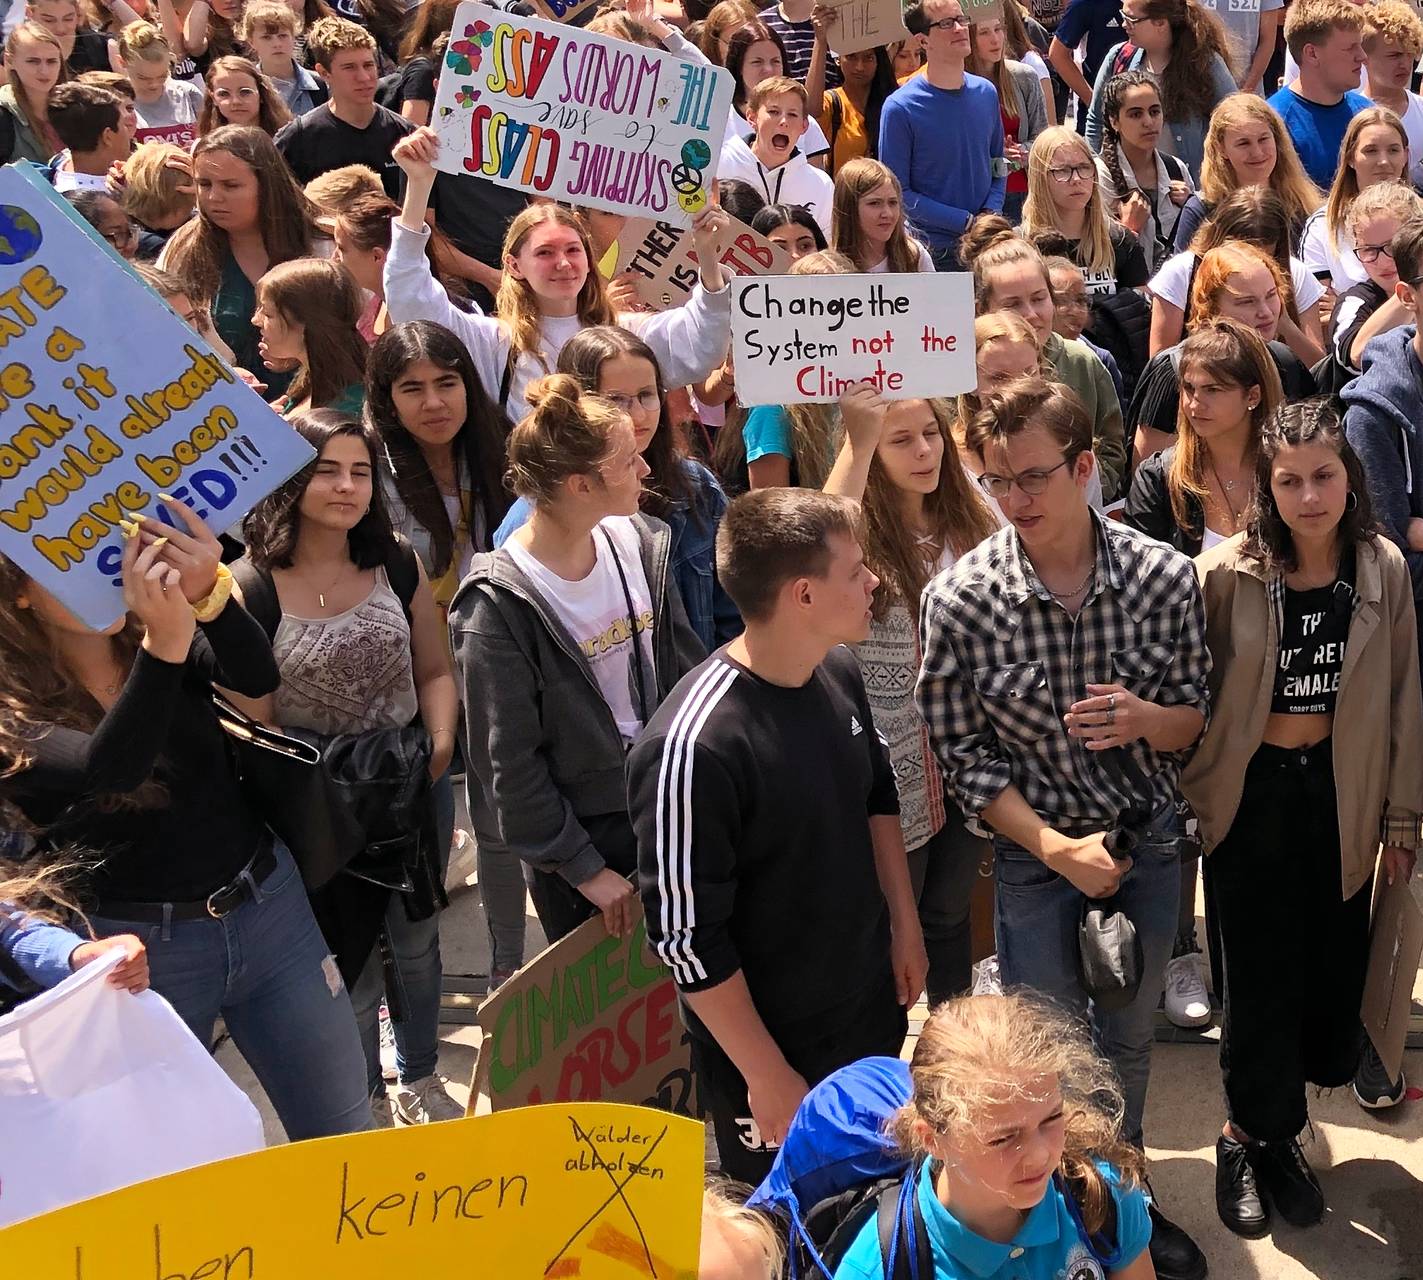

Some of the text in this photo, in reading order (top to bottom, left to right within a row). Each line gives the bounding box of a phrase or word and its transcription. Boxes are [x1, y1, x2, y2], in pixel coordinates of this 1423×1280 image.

[837, 5, 880, 41] THE
[486, 22, 560, 100] ASS
[670, 63, 718, 132] THE
[463, 105, 672, 213] SKIPPING CLASS
[518, 100, 675, 154] to save
[46, 326, 86, 362] a
[744, 325, 957, 366] System not the
[62, 362, 117, 411] it
[0, 344, 236, 533] would already
[32, 405, 239, 572] have been
[528, 978, 680, 1105] ORSE
[335, 1161, 528, 1244] keinen
